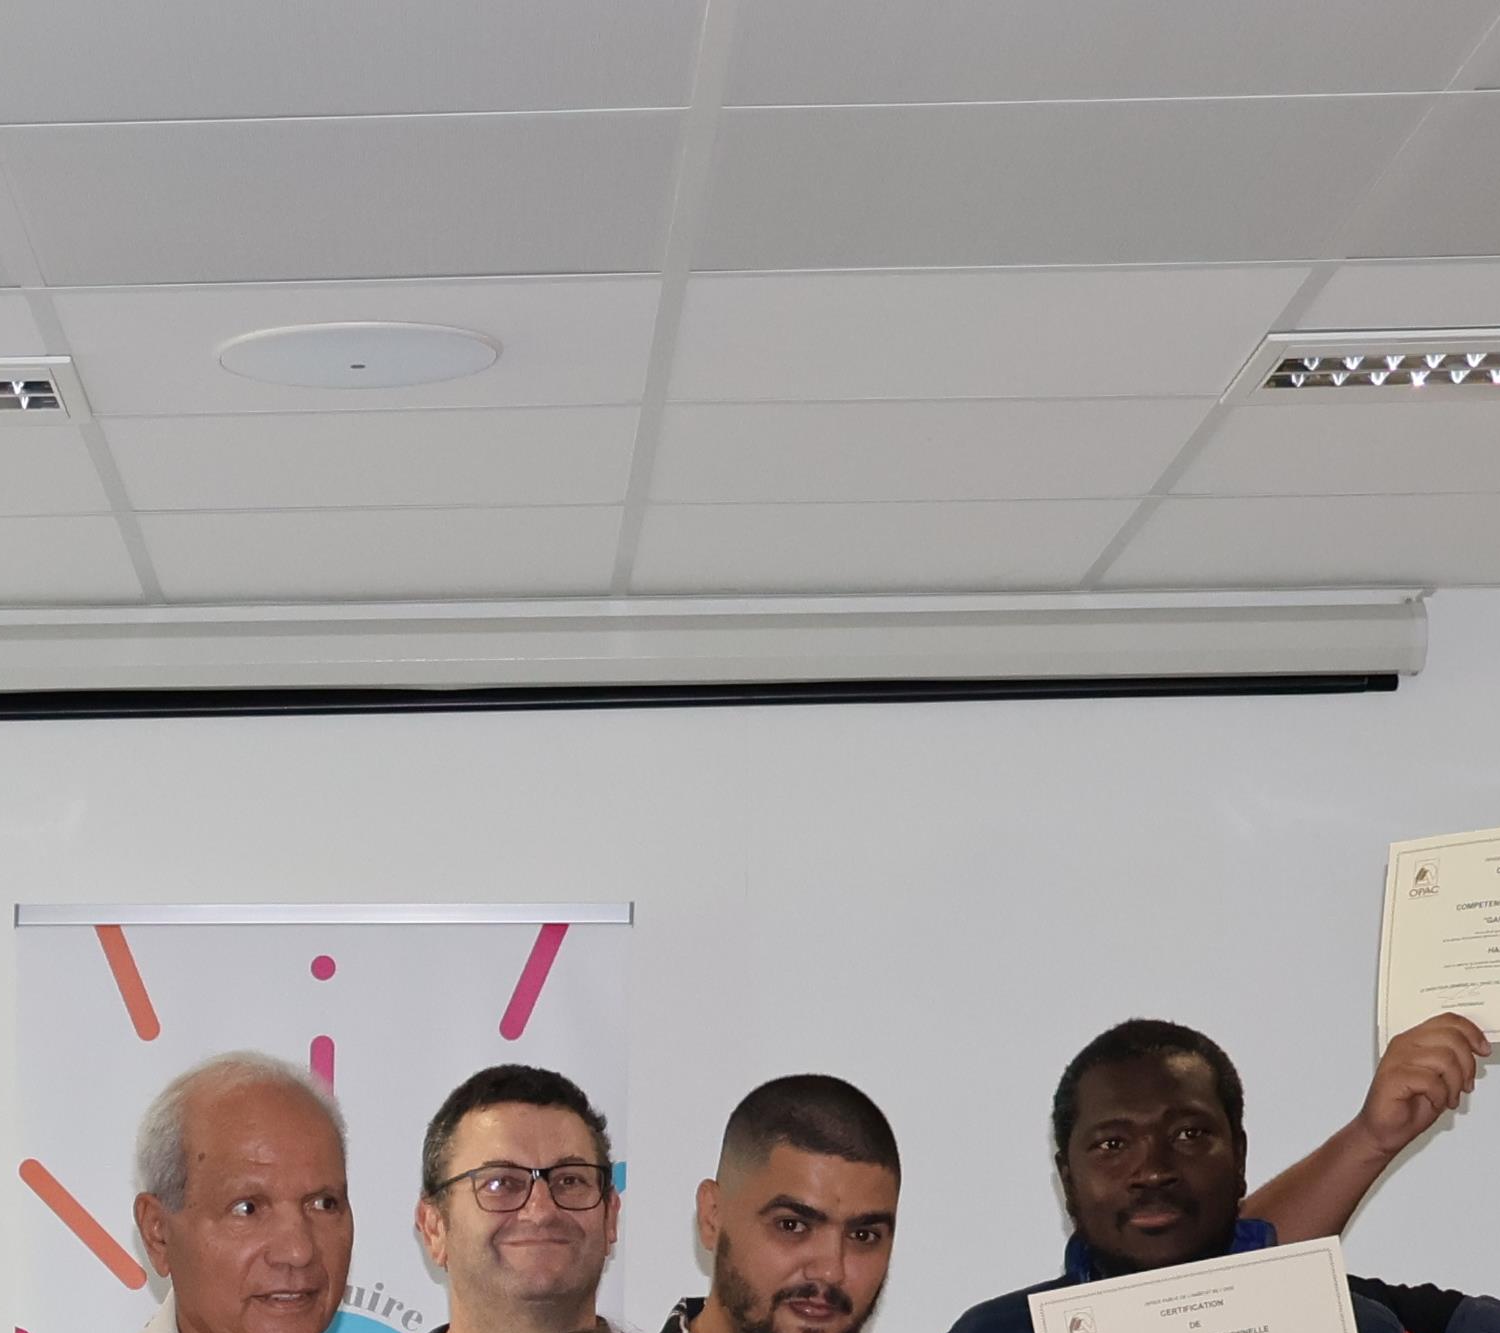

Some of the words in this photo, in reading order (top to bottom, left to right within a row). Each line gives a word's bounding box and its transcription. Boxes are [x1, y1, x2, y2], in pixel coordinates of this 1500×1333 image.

[1408, 885, 1440, 898] OPAC
[1160, 1299, 1224, 1317] CERTIFICATION
[1189, 1320, 1201, 1329] DE
